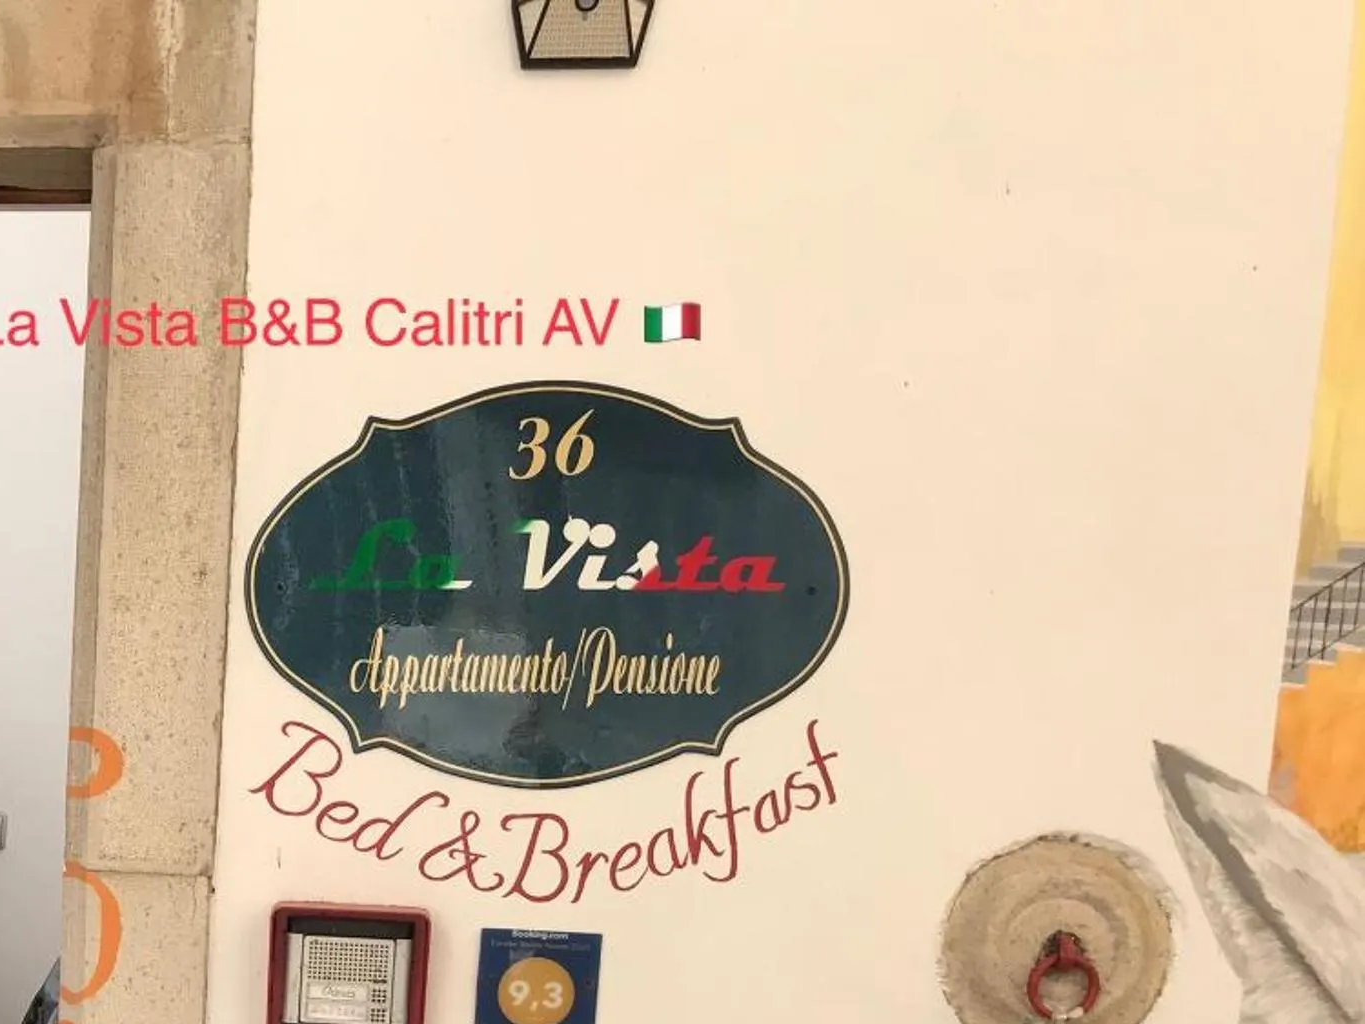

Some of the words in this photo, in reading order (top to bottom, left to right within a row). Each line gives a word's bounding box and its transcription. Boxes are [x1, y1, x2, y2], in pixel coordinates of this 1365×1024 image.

[509, 409, 596, 480] 36
[308, 518, 473, 592] La
[510, 518, 787, 593] Vista
[248, 720, 450, 860] Bed
[418, 810, 504, 892] &
[501, 719, 839, 904] Breakfast
[508, 979, 564, 1012] 9,3
